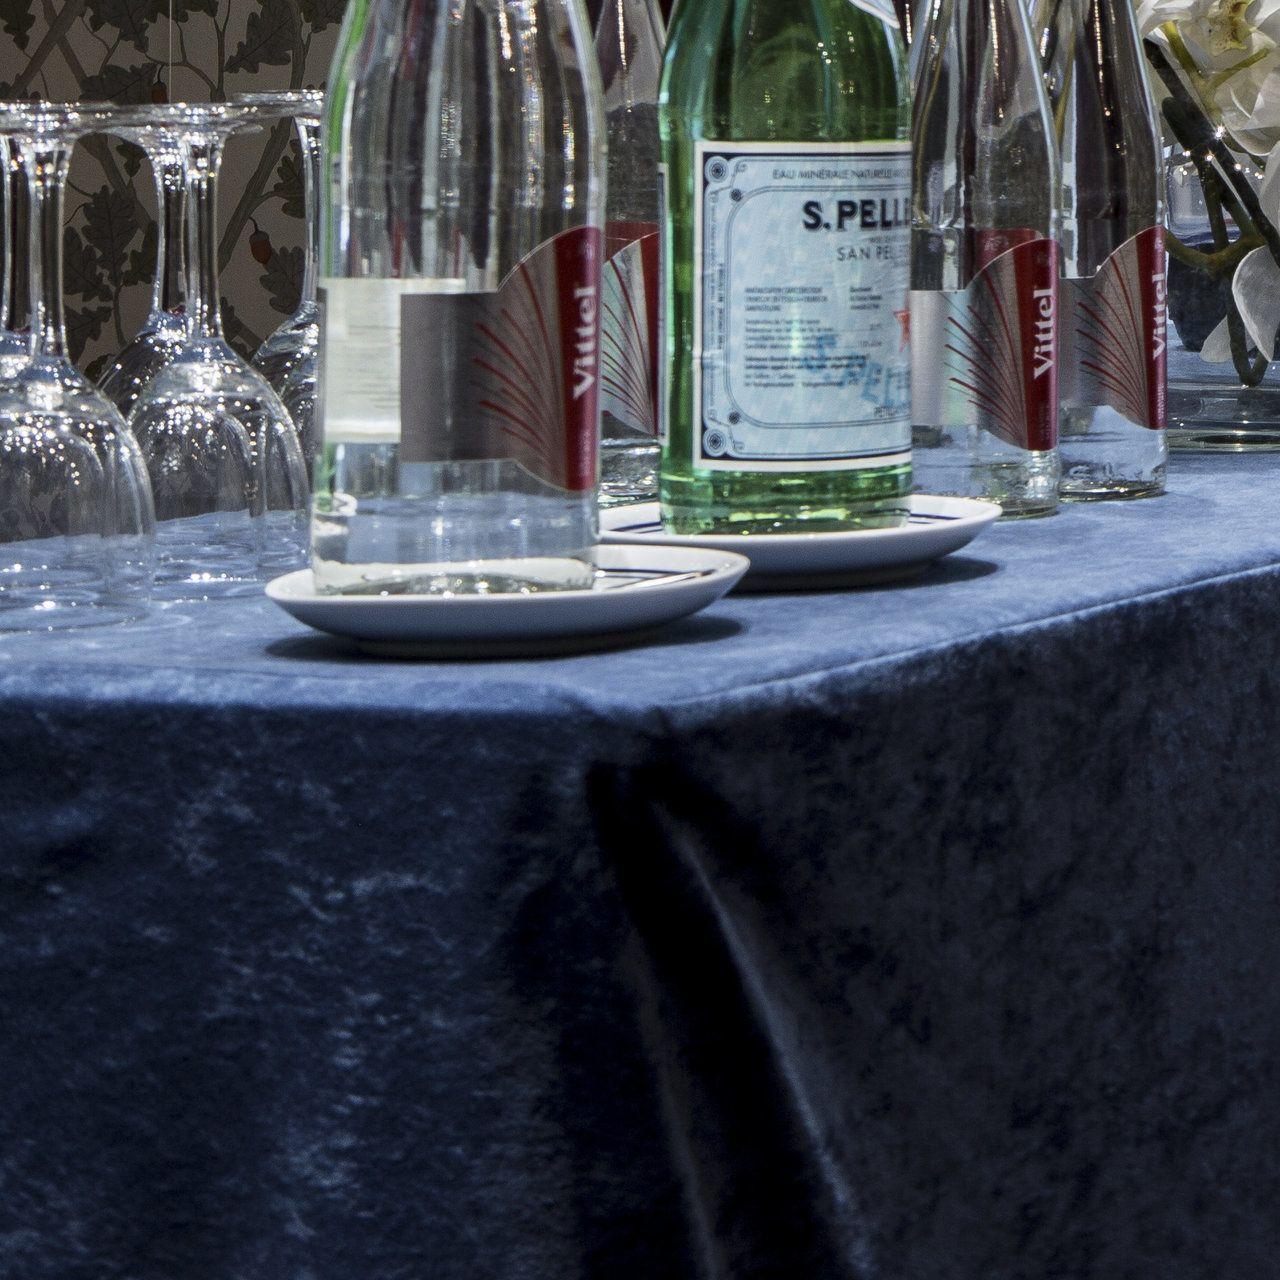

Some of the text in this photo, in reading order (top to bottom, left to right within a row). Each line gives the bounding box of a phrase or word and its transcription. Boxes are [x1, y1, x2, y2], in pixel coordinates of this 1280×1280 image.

[573, 287, 597, 400] Vittel
[1032, 286, 1056, 380] Vittel
[1152, 273, 1166, 360] Vittel
